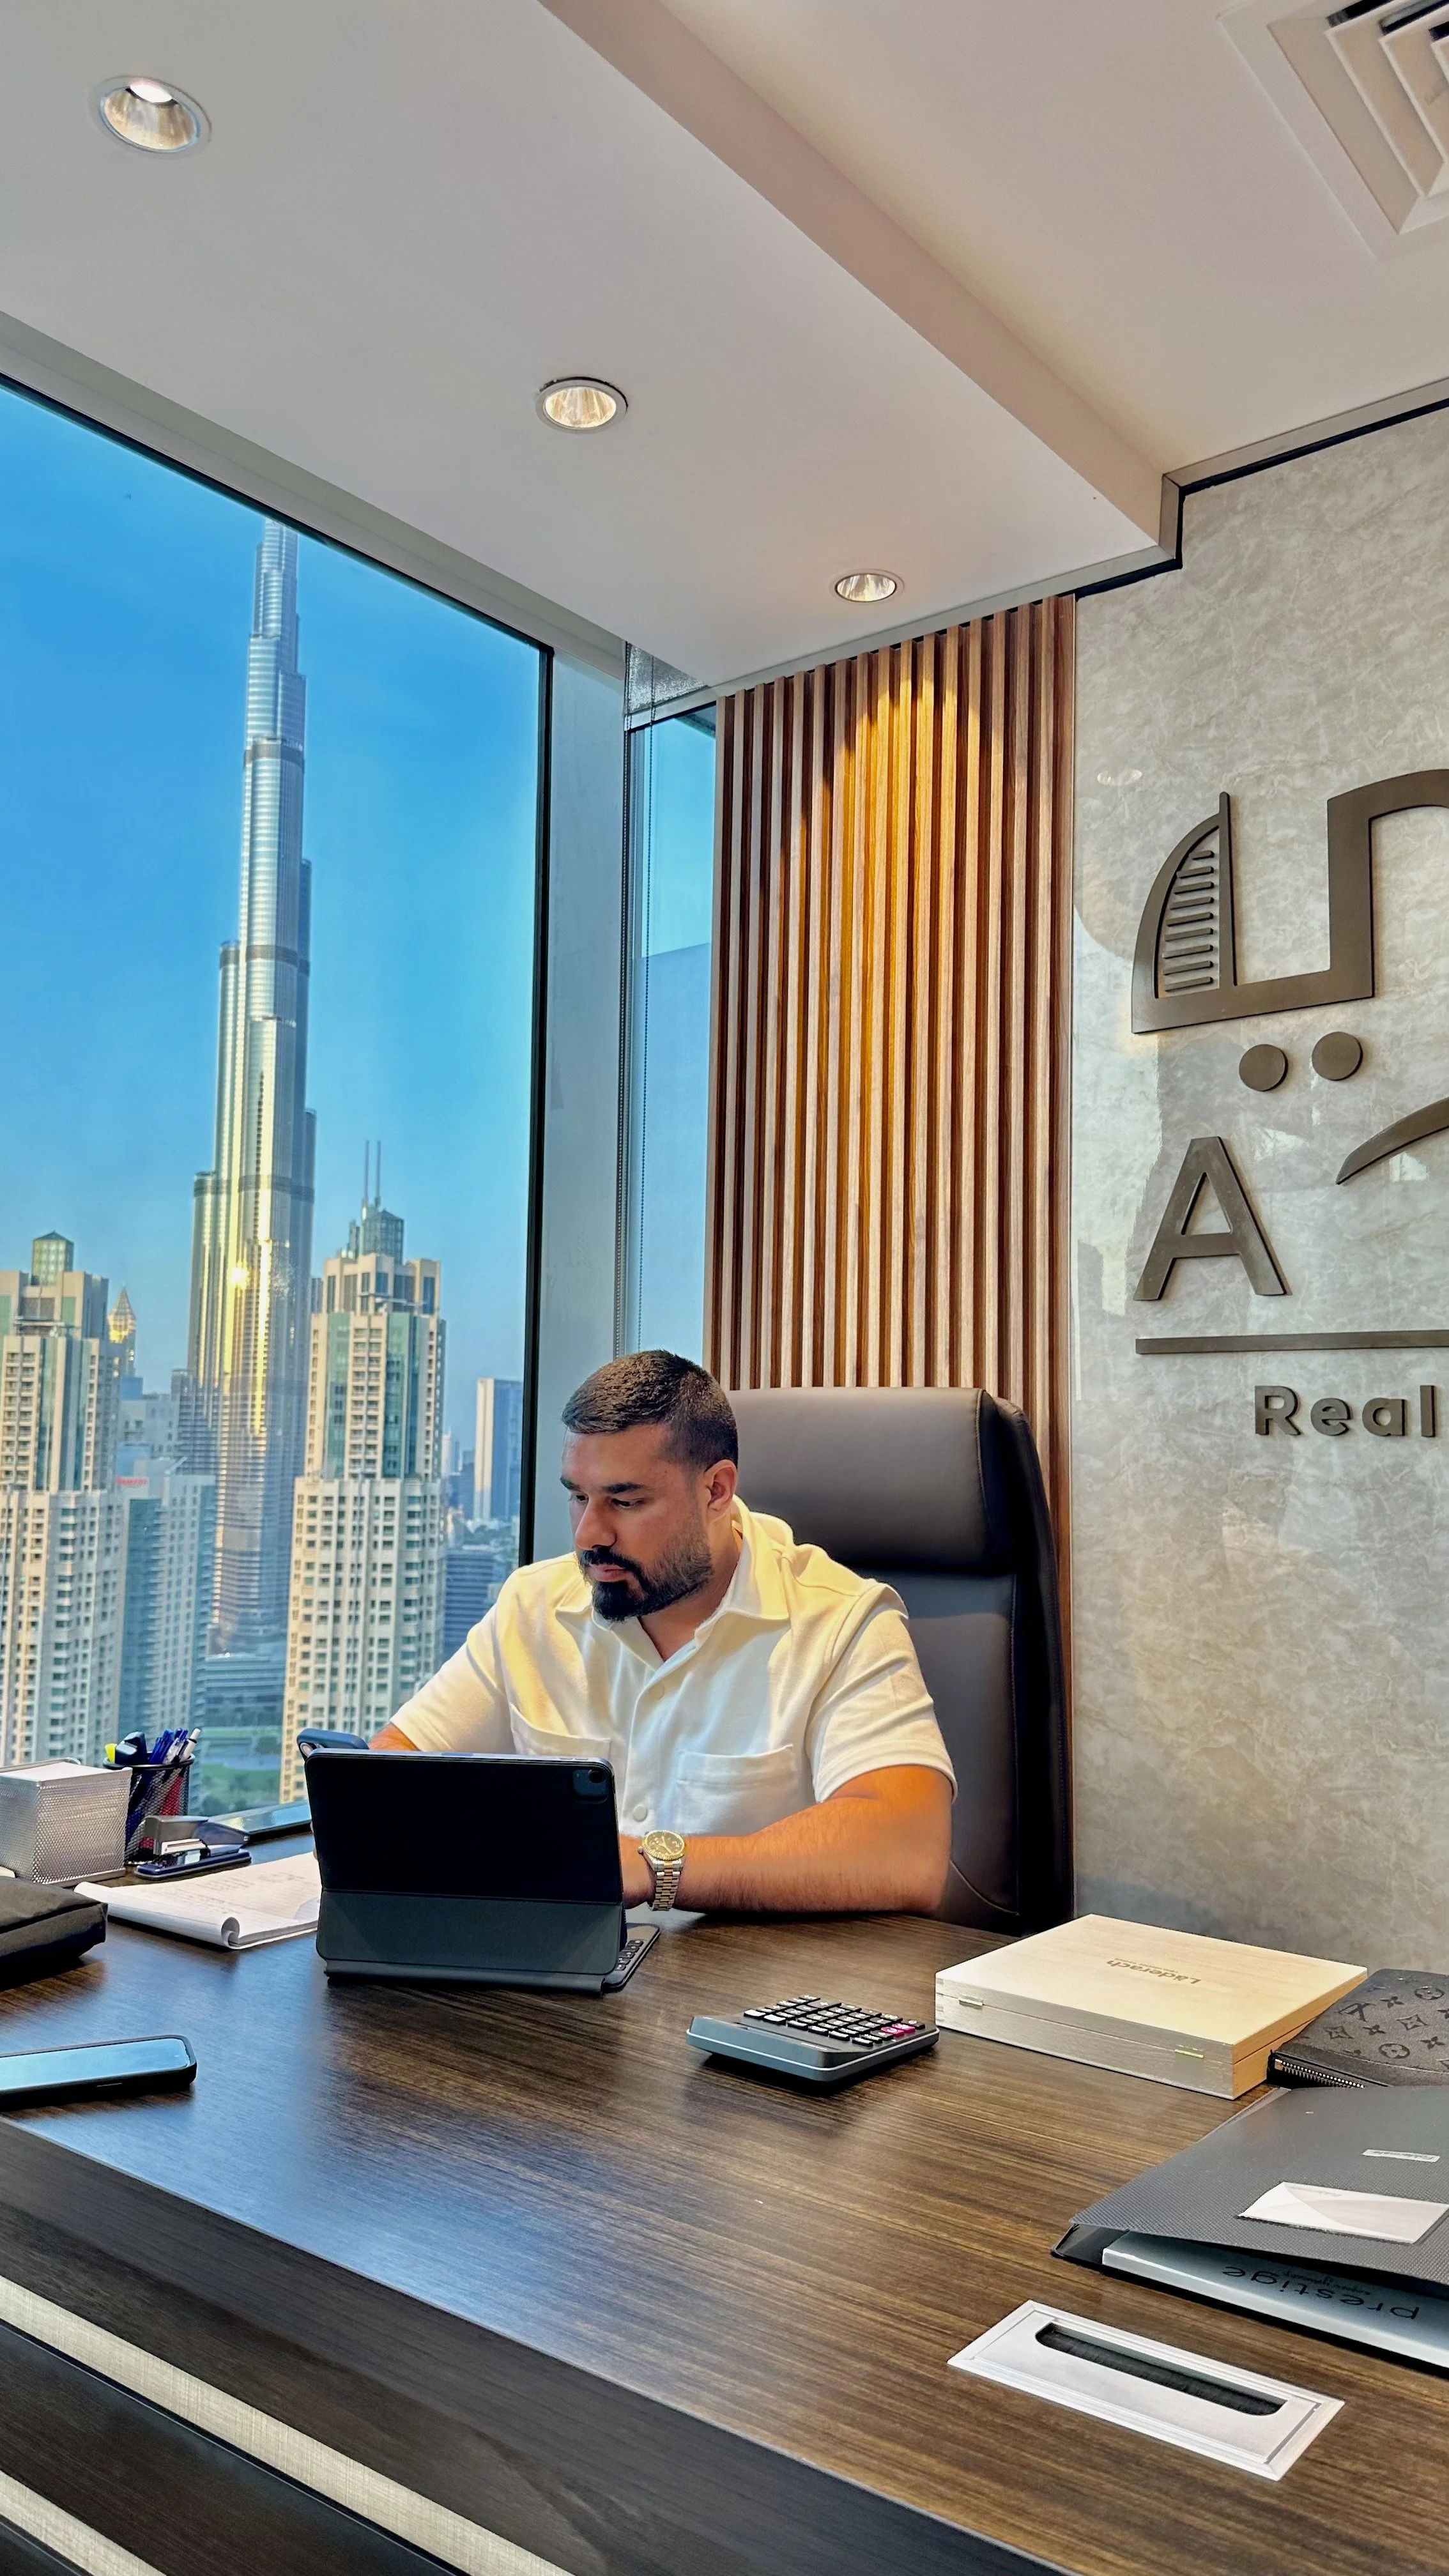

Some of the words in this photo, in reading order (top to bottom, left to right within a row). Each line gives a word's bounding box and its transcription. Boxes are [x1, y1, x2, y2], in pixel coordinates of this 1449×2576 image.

[1255, 1384, 1436, 1438] Real
[1107, 1960, 1201, 1984] Läderach
[1222, 2267, 1420, 2320] prestige
